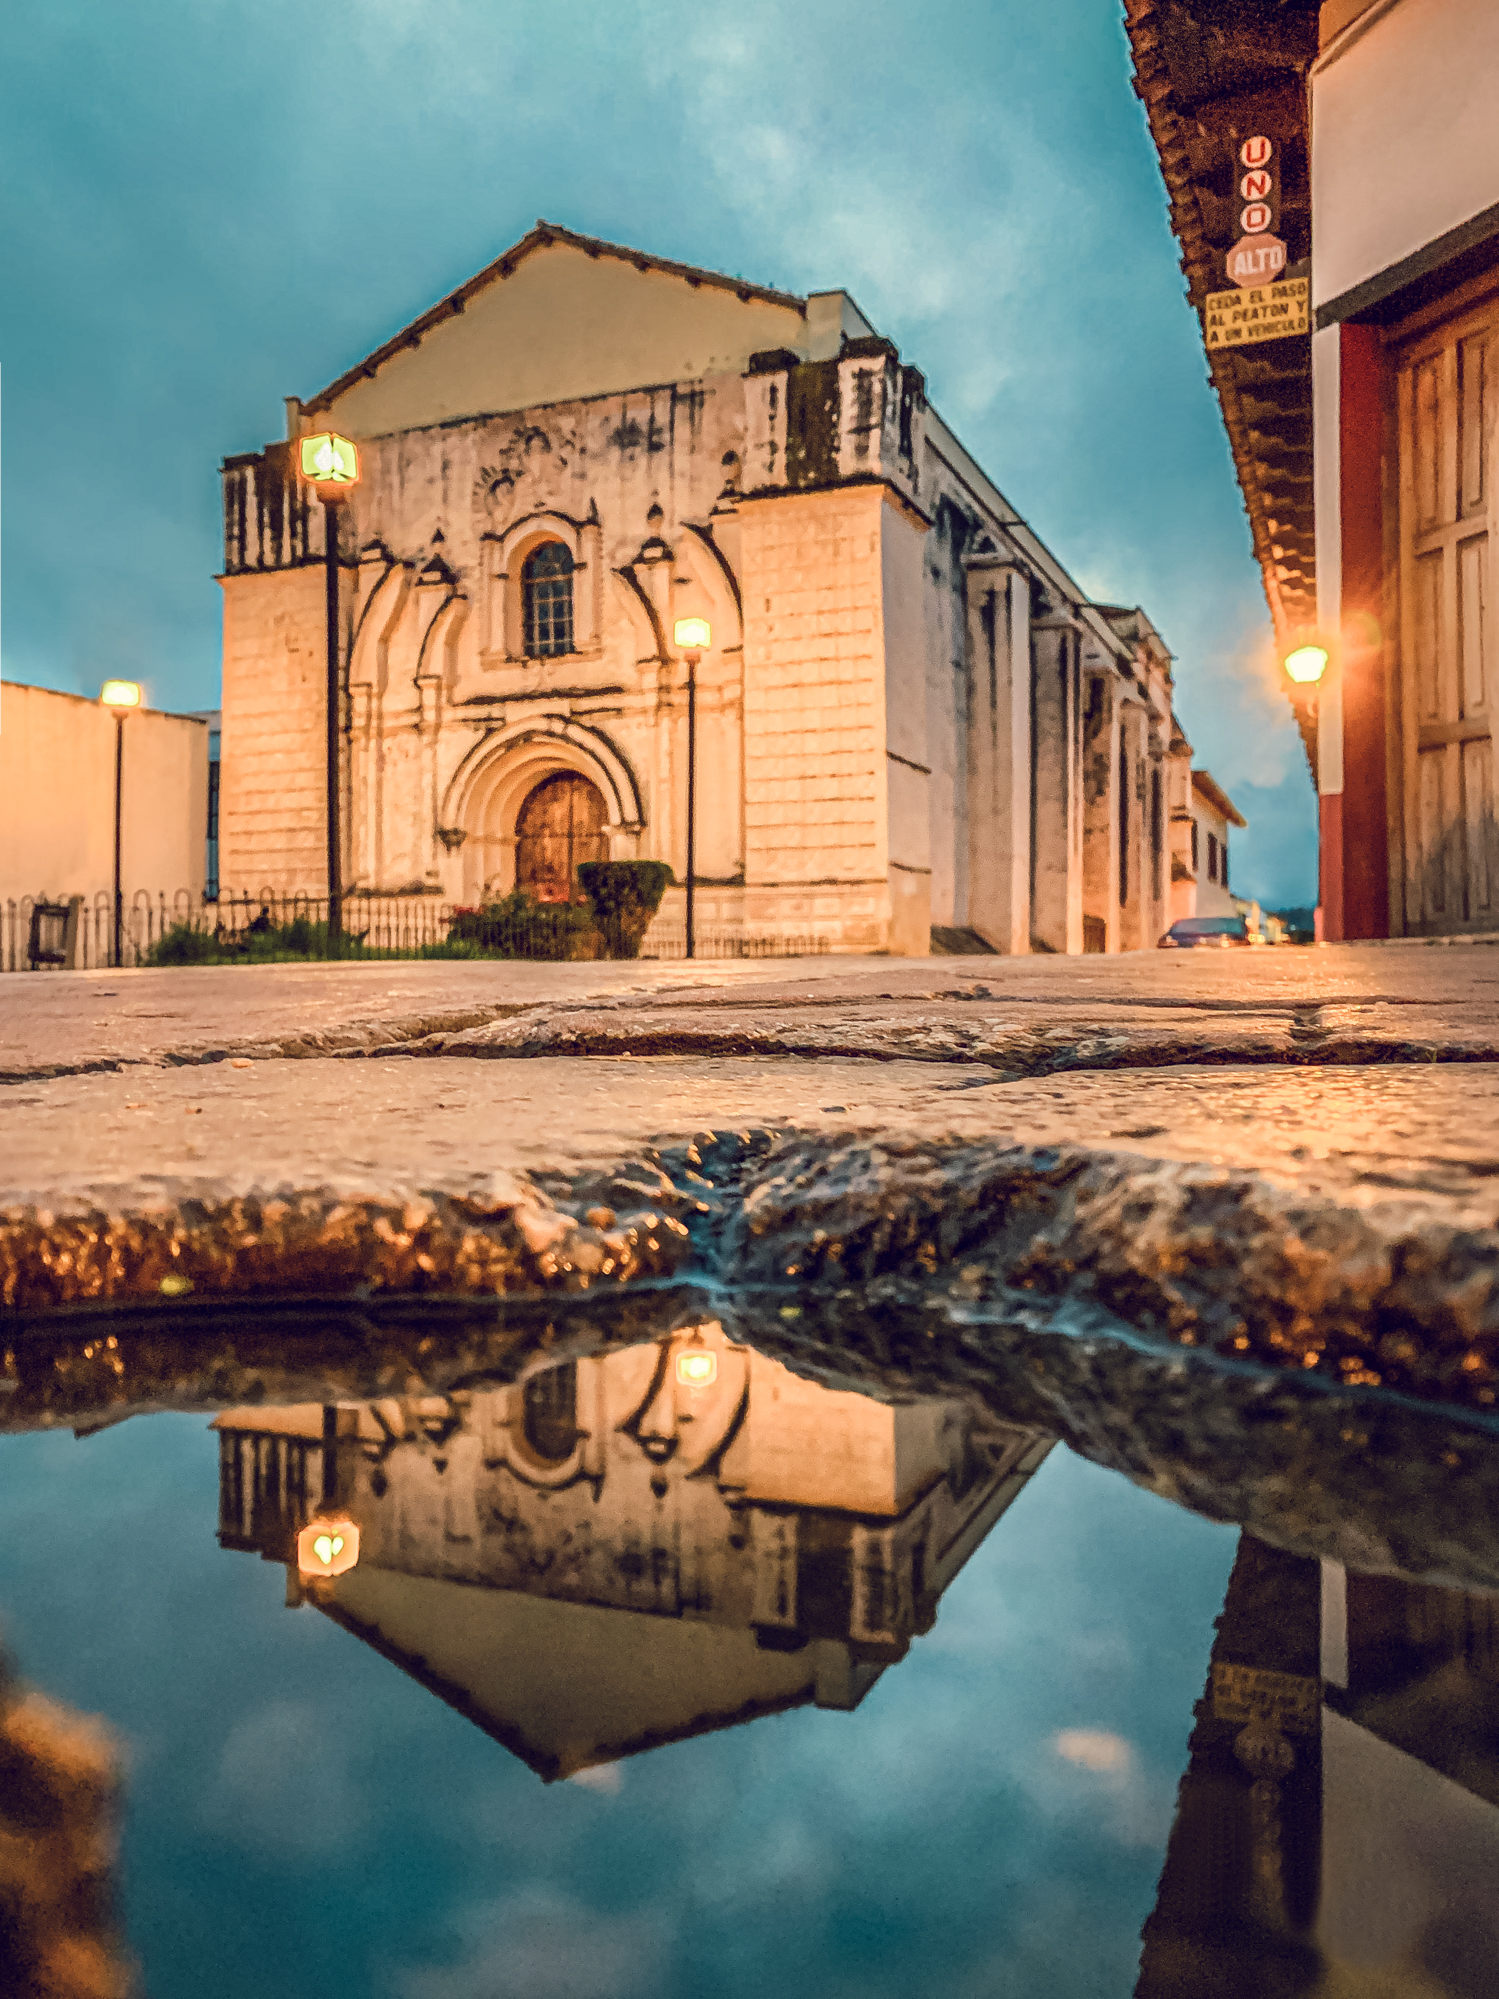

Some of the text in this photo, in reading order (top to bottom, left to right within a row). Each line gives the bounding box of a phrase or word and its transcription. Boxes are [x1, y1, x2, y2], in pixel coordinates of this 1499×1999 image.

[1246, 139, 1266, 227] UNO
[1234, 246, 1283, 276] ALTO
[1208, 282, 1306, 311] CEDA EL PASO
[1210, 300, 1306, 327] AL PEATON Y
[1210, 317, 1306, 342] A UN VEHICULO
